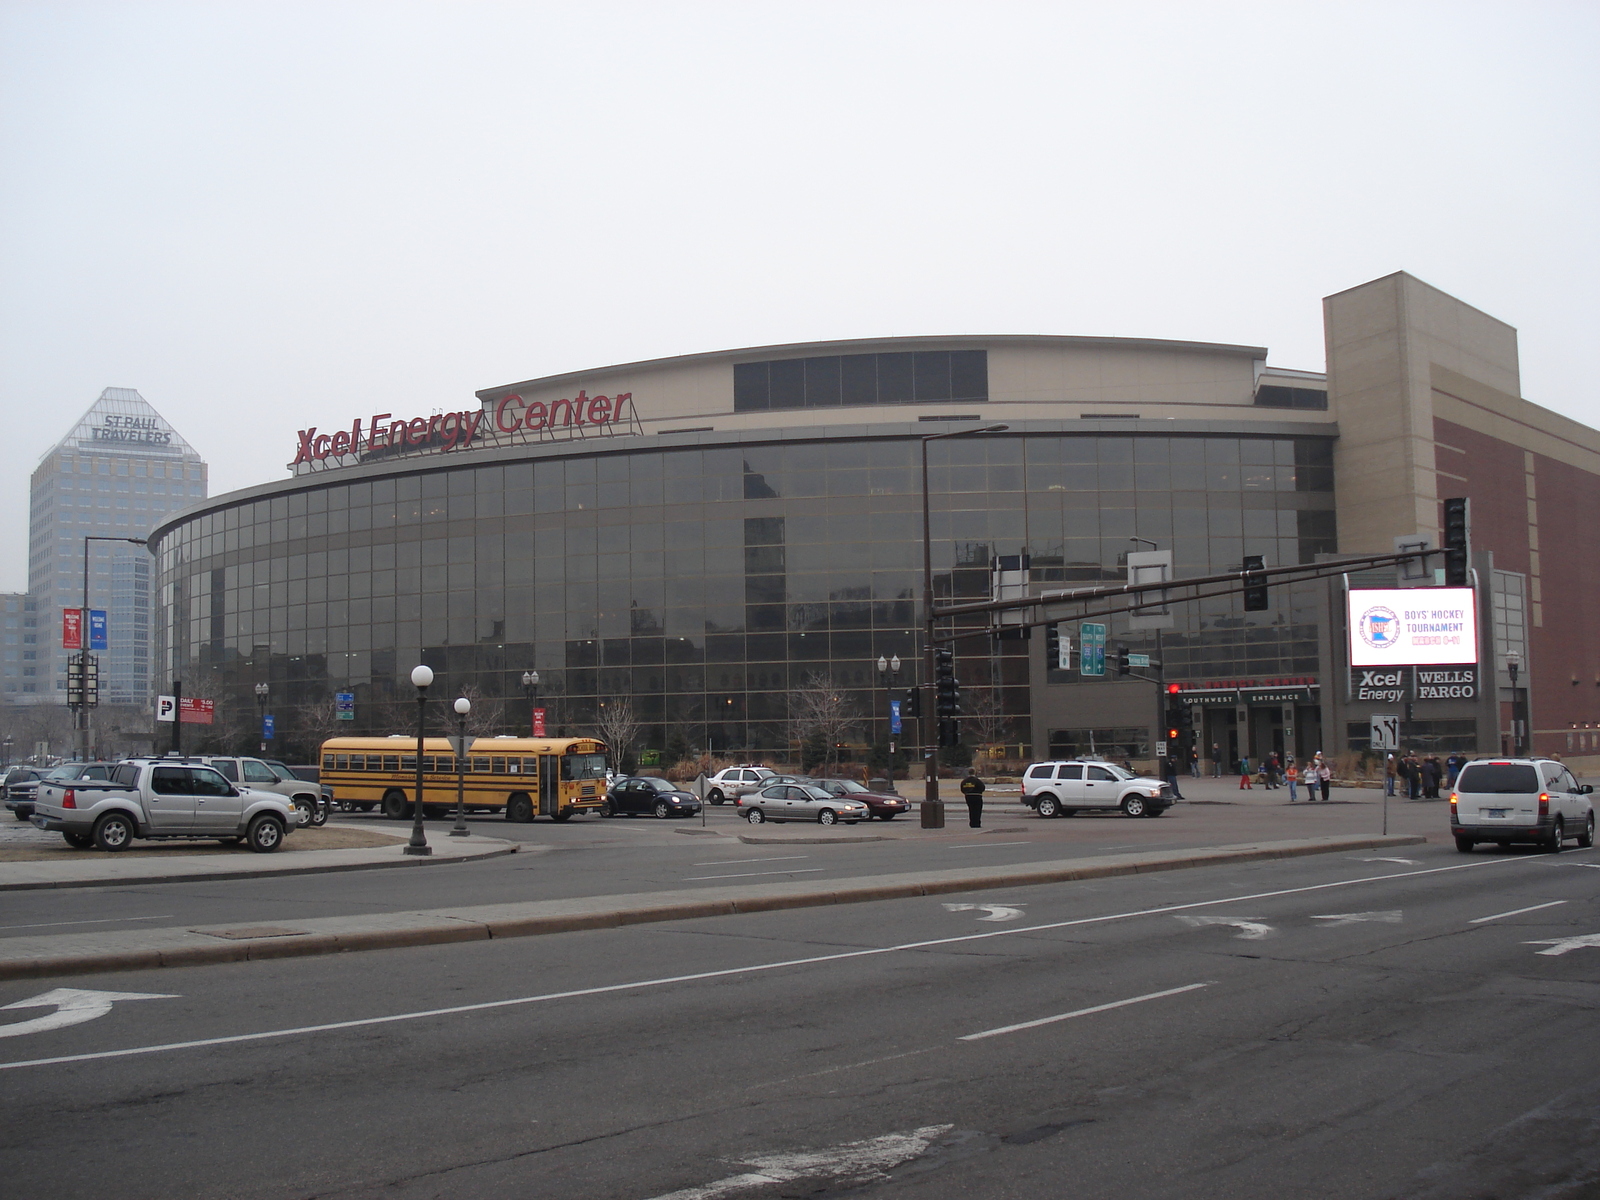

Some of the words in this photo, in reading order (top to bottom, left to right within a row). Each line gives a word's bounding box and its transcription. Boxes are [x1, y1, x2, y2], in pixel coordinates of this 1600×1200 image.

[124, 416, 159, 430] PAUL
[294, 418, 362, 465] Xcel
[368, 409, 486, 451] Energy
[496, 390, 633, 434] Center
[92, 427, 171, 445] TRAVELERS
[1404, 610, 1429, 620] BOYS'
[1431, 609, 1464, 619] HOCKEY
[1407, 622, 1464, 633] TOURNAMENT
[1359, 670, 1402, 687] Xcel
[1418, 670, 1474, 684] WELLS
[1183, 696, 1233, 704] SOUTHWEST
[1252, 694, 1299, 702] ENTRANCE
[1358, 687, 1405, 703] Energy
[1419, 685, 1474, 699] FARGO
